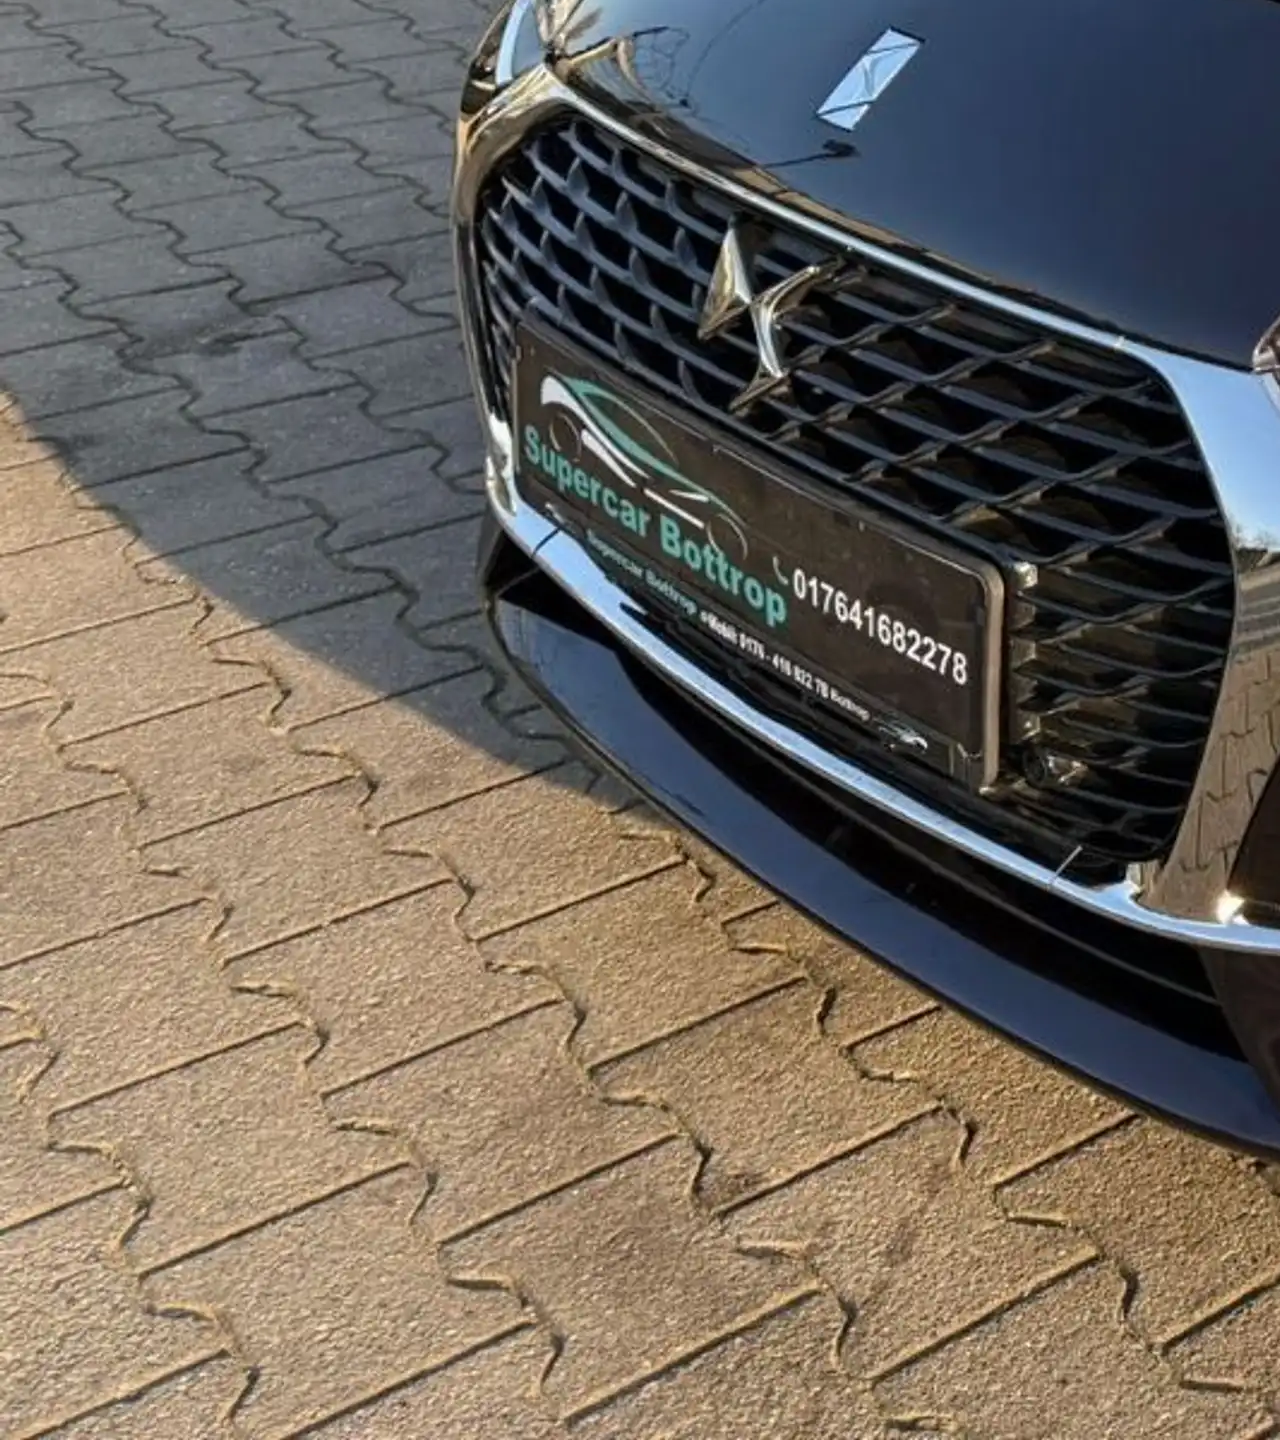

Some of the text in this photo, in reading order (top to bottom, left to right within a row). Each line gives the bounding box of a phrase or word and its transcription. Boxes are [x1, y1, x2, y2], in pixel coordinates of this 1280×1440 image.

[524, 425, 788, 629] Supercar Bottrop
[793, 568, 969, 687] 017641682278
